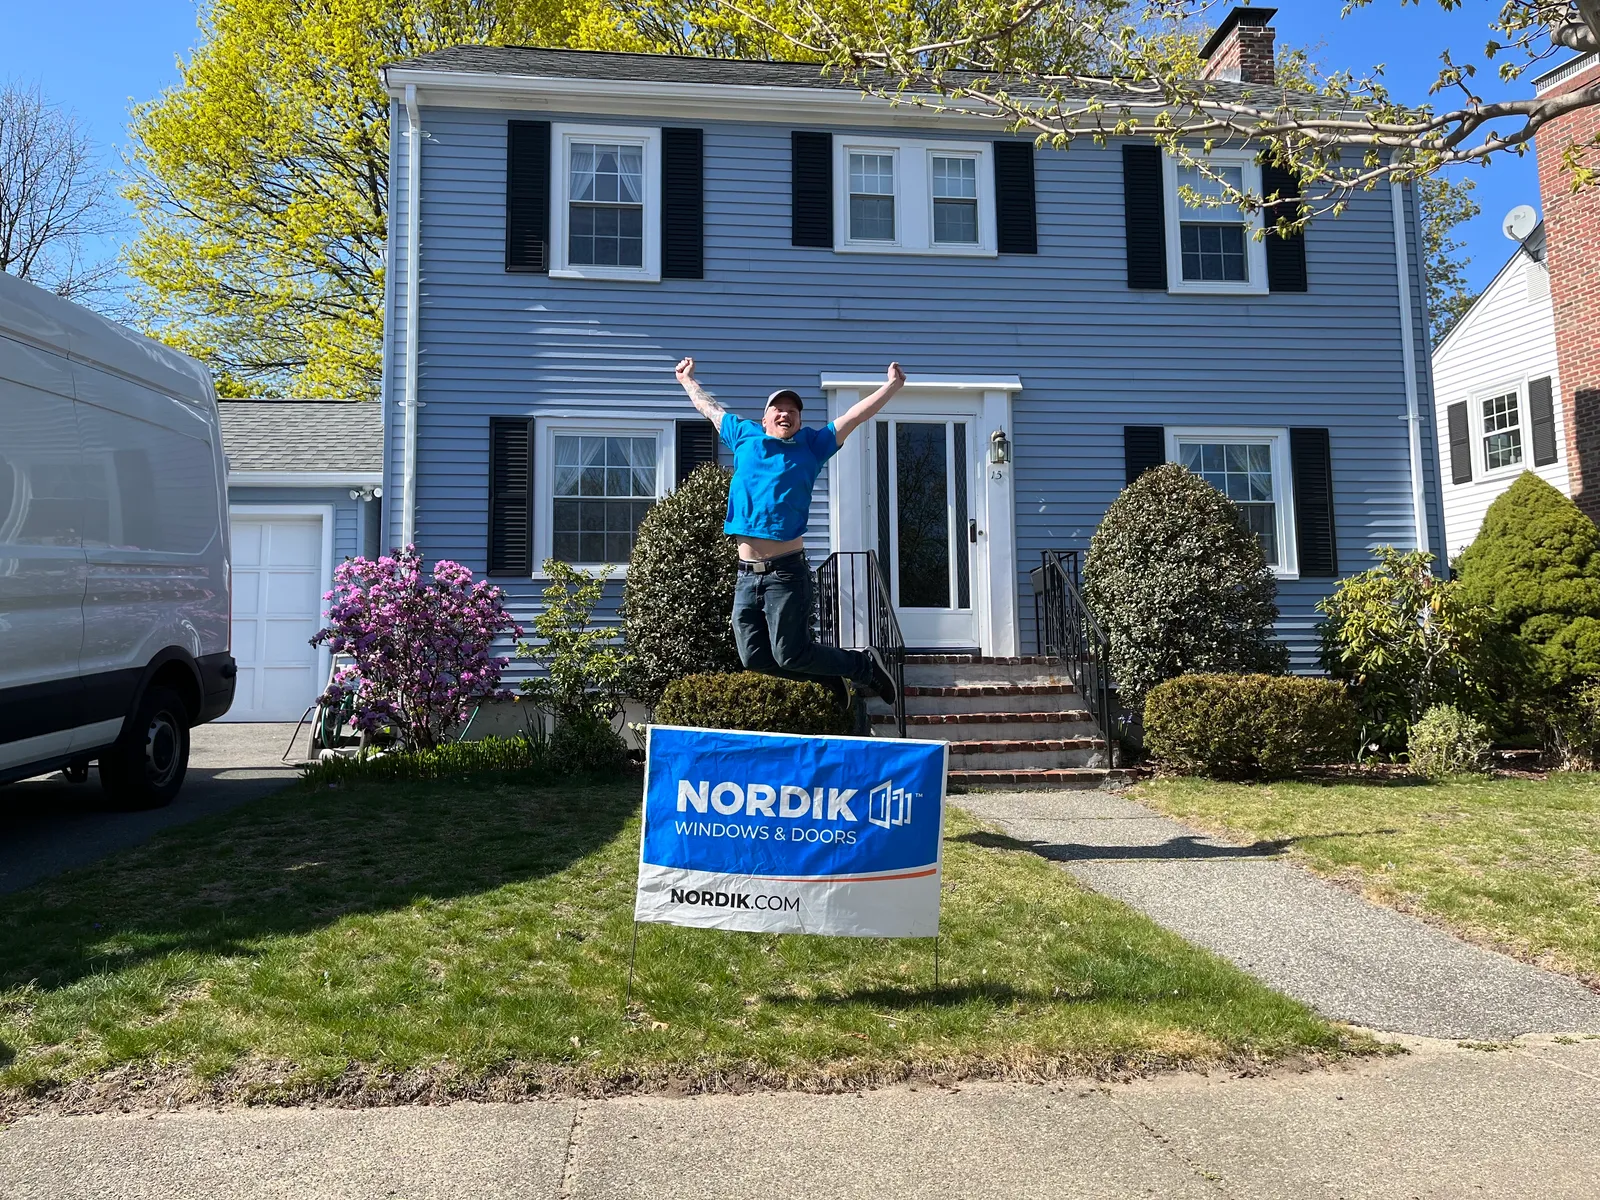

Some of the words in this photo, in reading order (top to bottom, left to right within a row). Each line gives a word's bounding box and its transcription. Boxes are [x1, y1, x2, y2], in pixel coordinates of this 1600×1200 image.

[676, 779, 858, 822] NORDIK
[675, 820, 769, 840] WINDOWS
[774, 826, 786, 841] &
[791, 828, 857, 845] DOORS
[671, 888, 800, 912] NORDIK.COM
